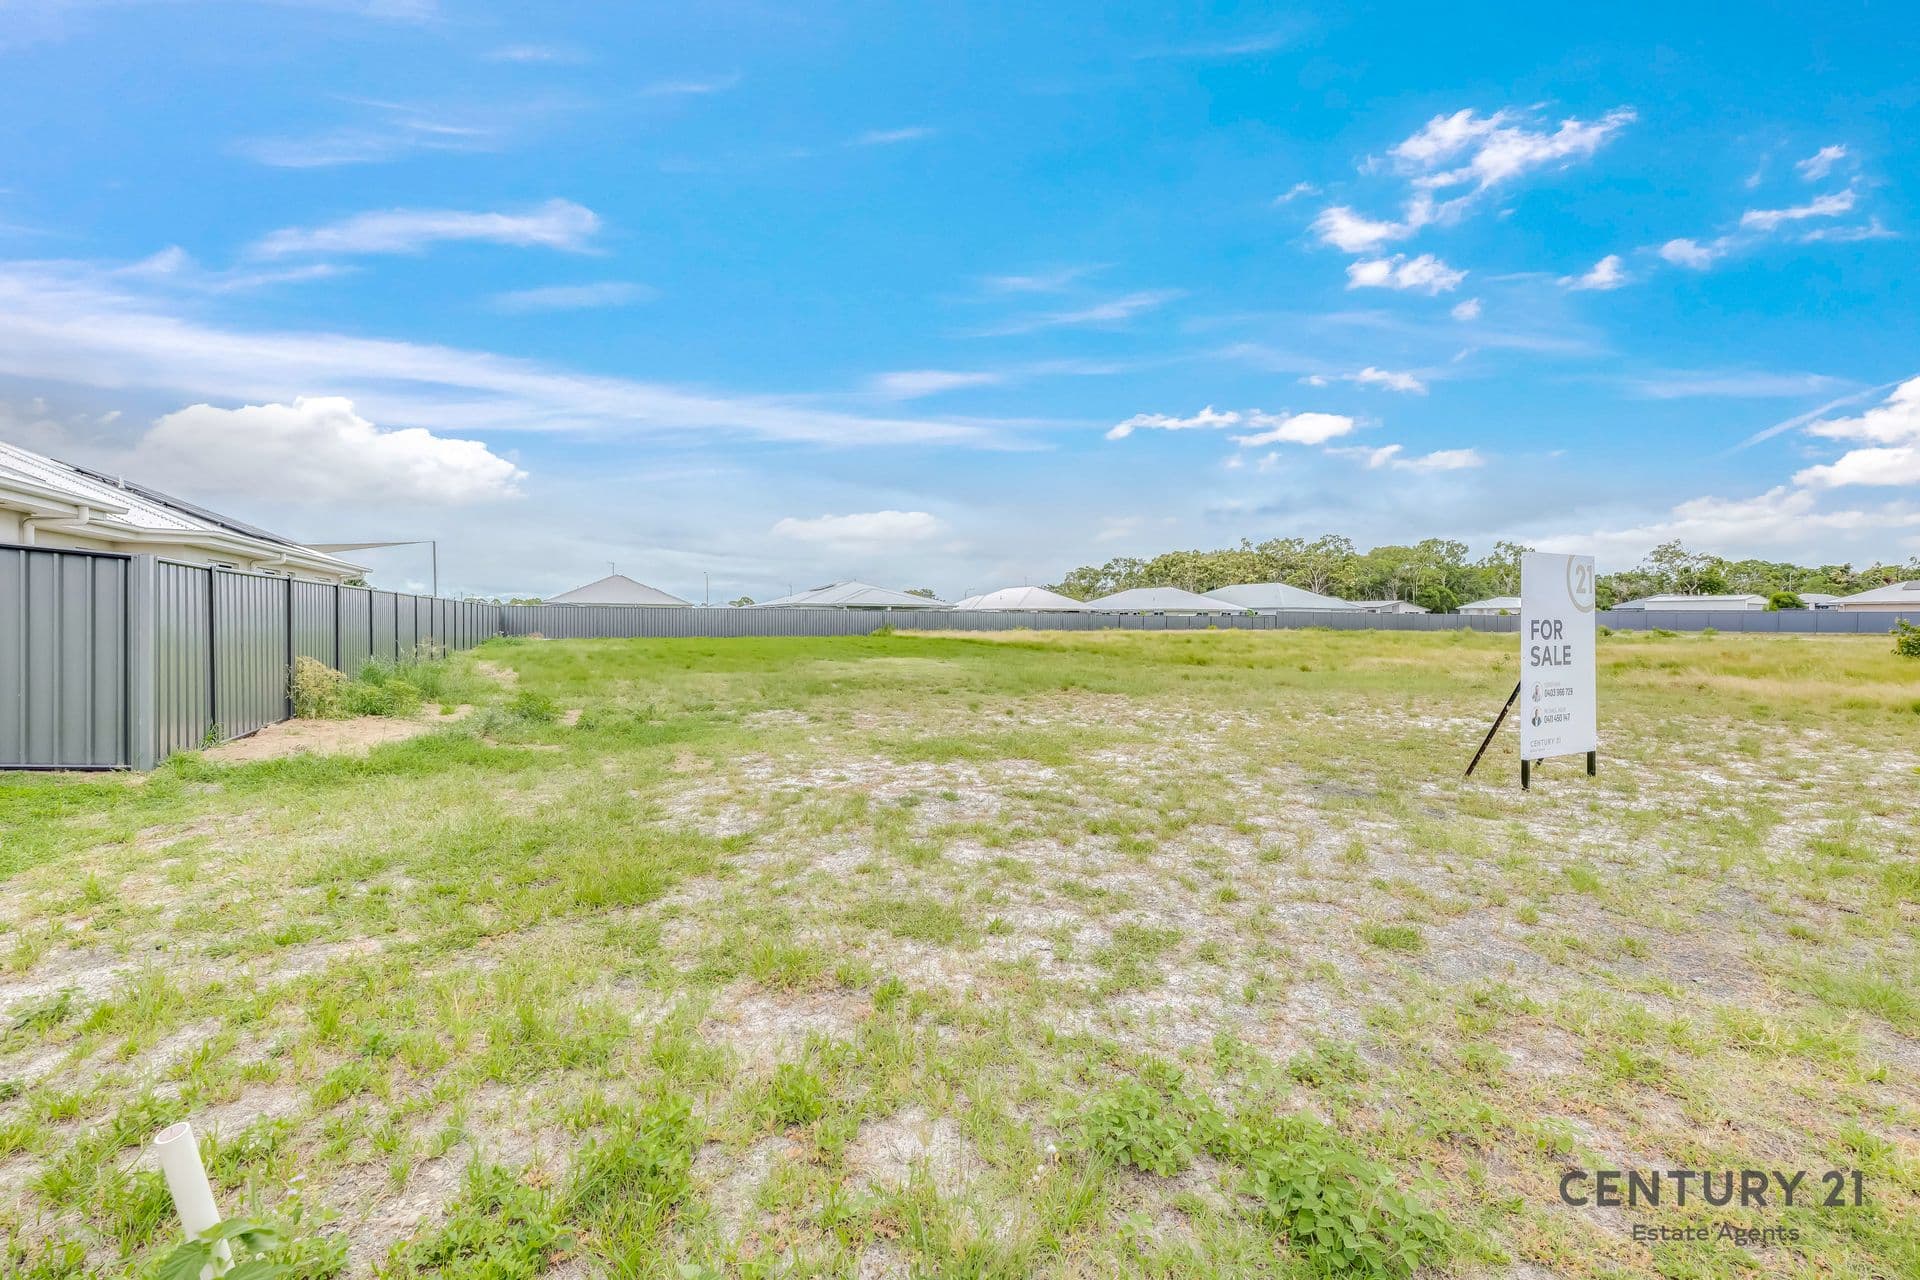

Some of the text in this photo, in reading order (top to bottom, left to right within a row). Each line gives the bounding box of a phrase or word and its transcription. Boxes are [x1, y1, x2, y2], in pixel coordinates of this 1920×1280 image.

[1576, 564, 1592, 594] 21
[1531, 619, 1563, 640] FOR
[1530, 645, 1571, 667] SALE
[1530, 738, 1555, 747] CENTURY
